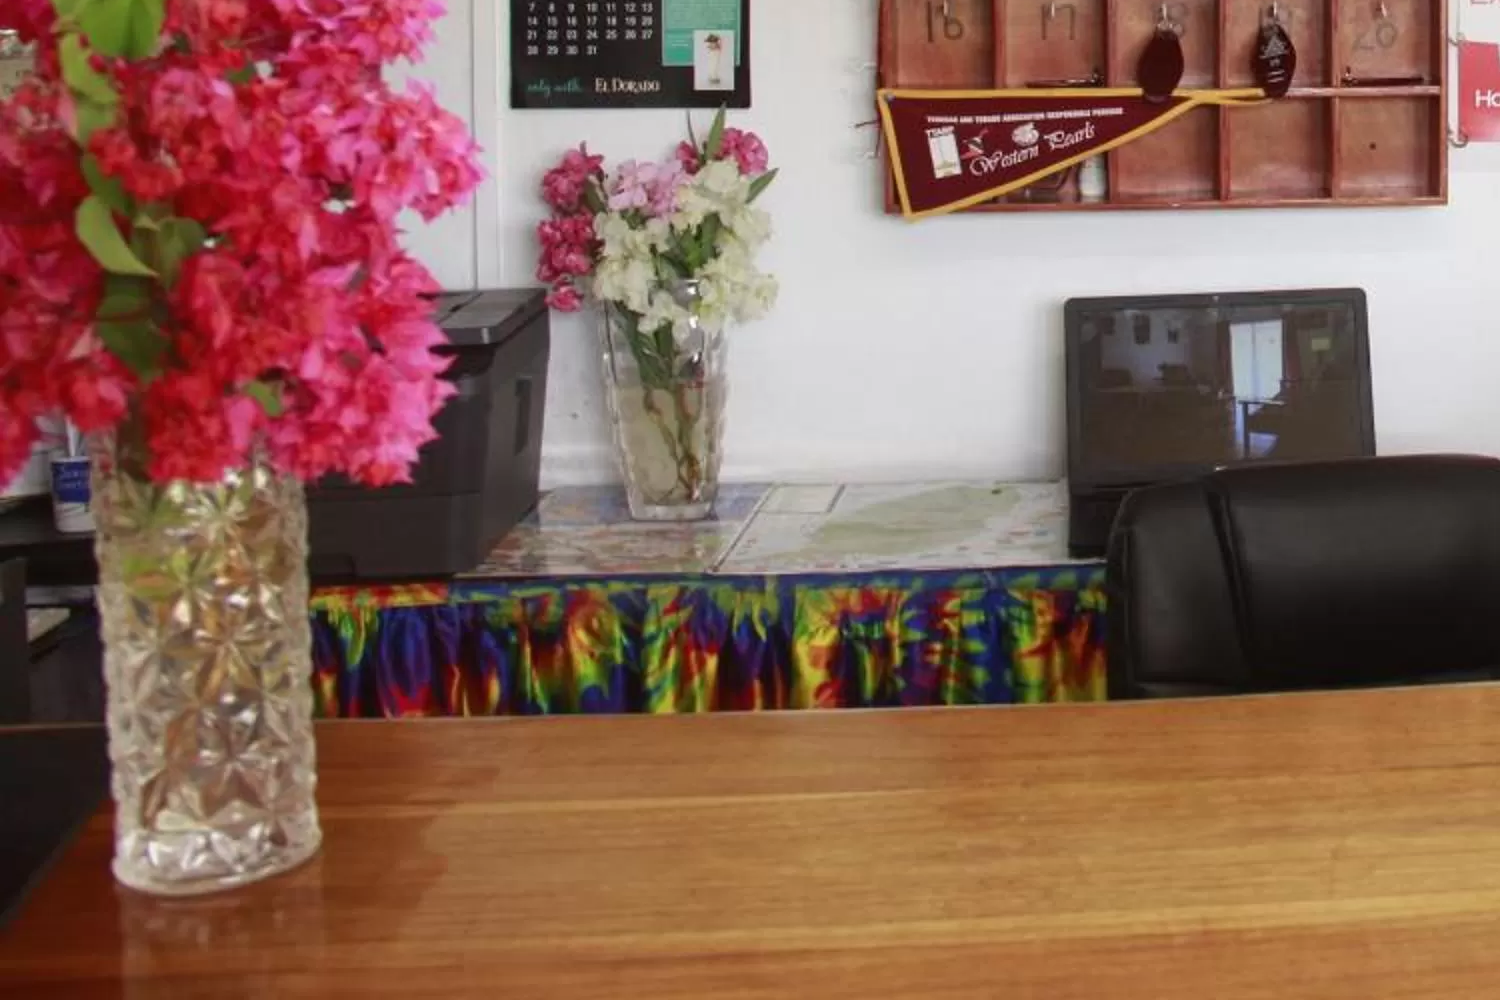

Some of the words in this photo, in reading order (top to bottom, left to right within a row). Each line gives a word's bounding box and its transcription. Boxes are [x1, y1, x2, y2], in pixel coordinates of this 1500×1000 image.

[595, 77, 610, 92] EL
[611, 77, 661, 94] DORADO
[969, 145, 1040, 176] Western
